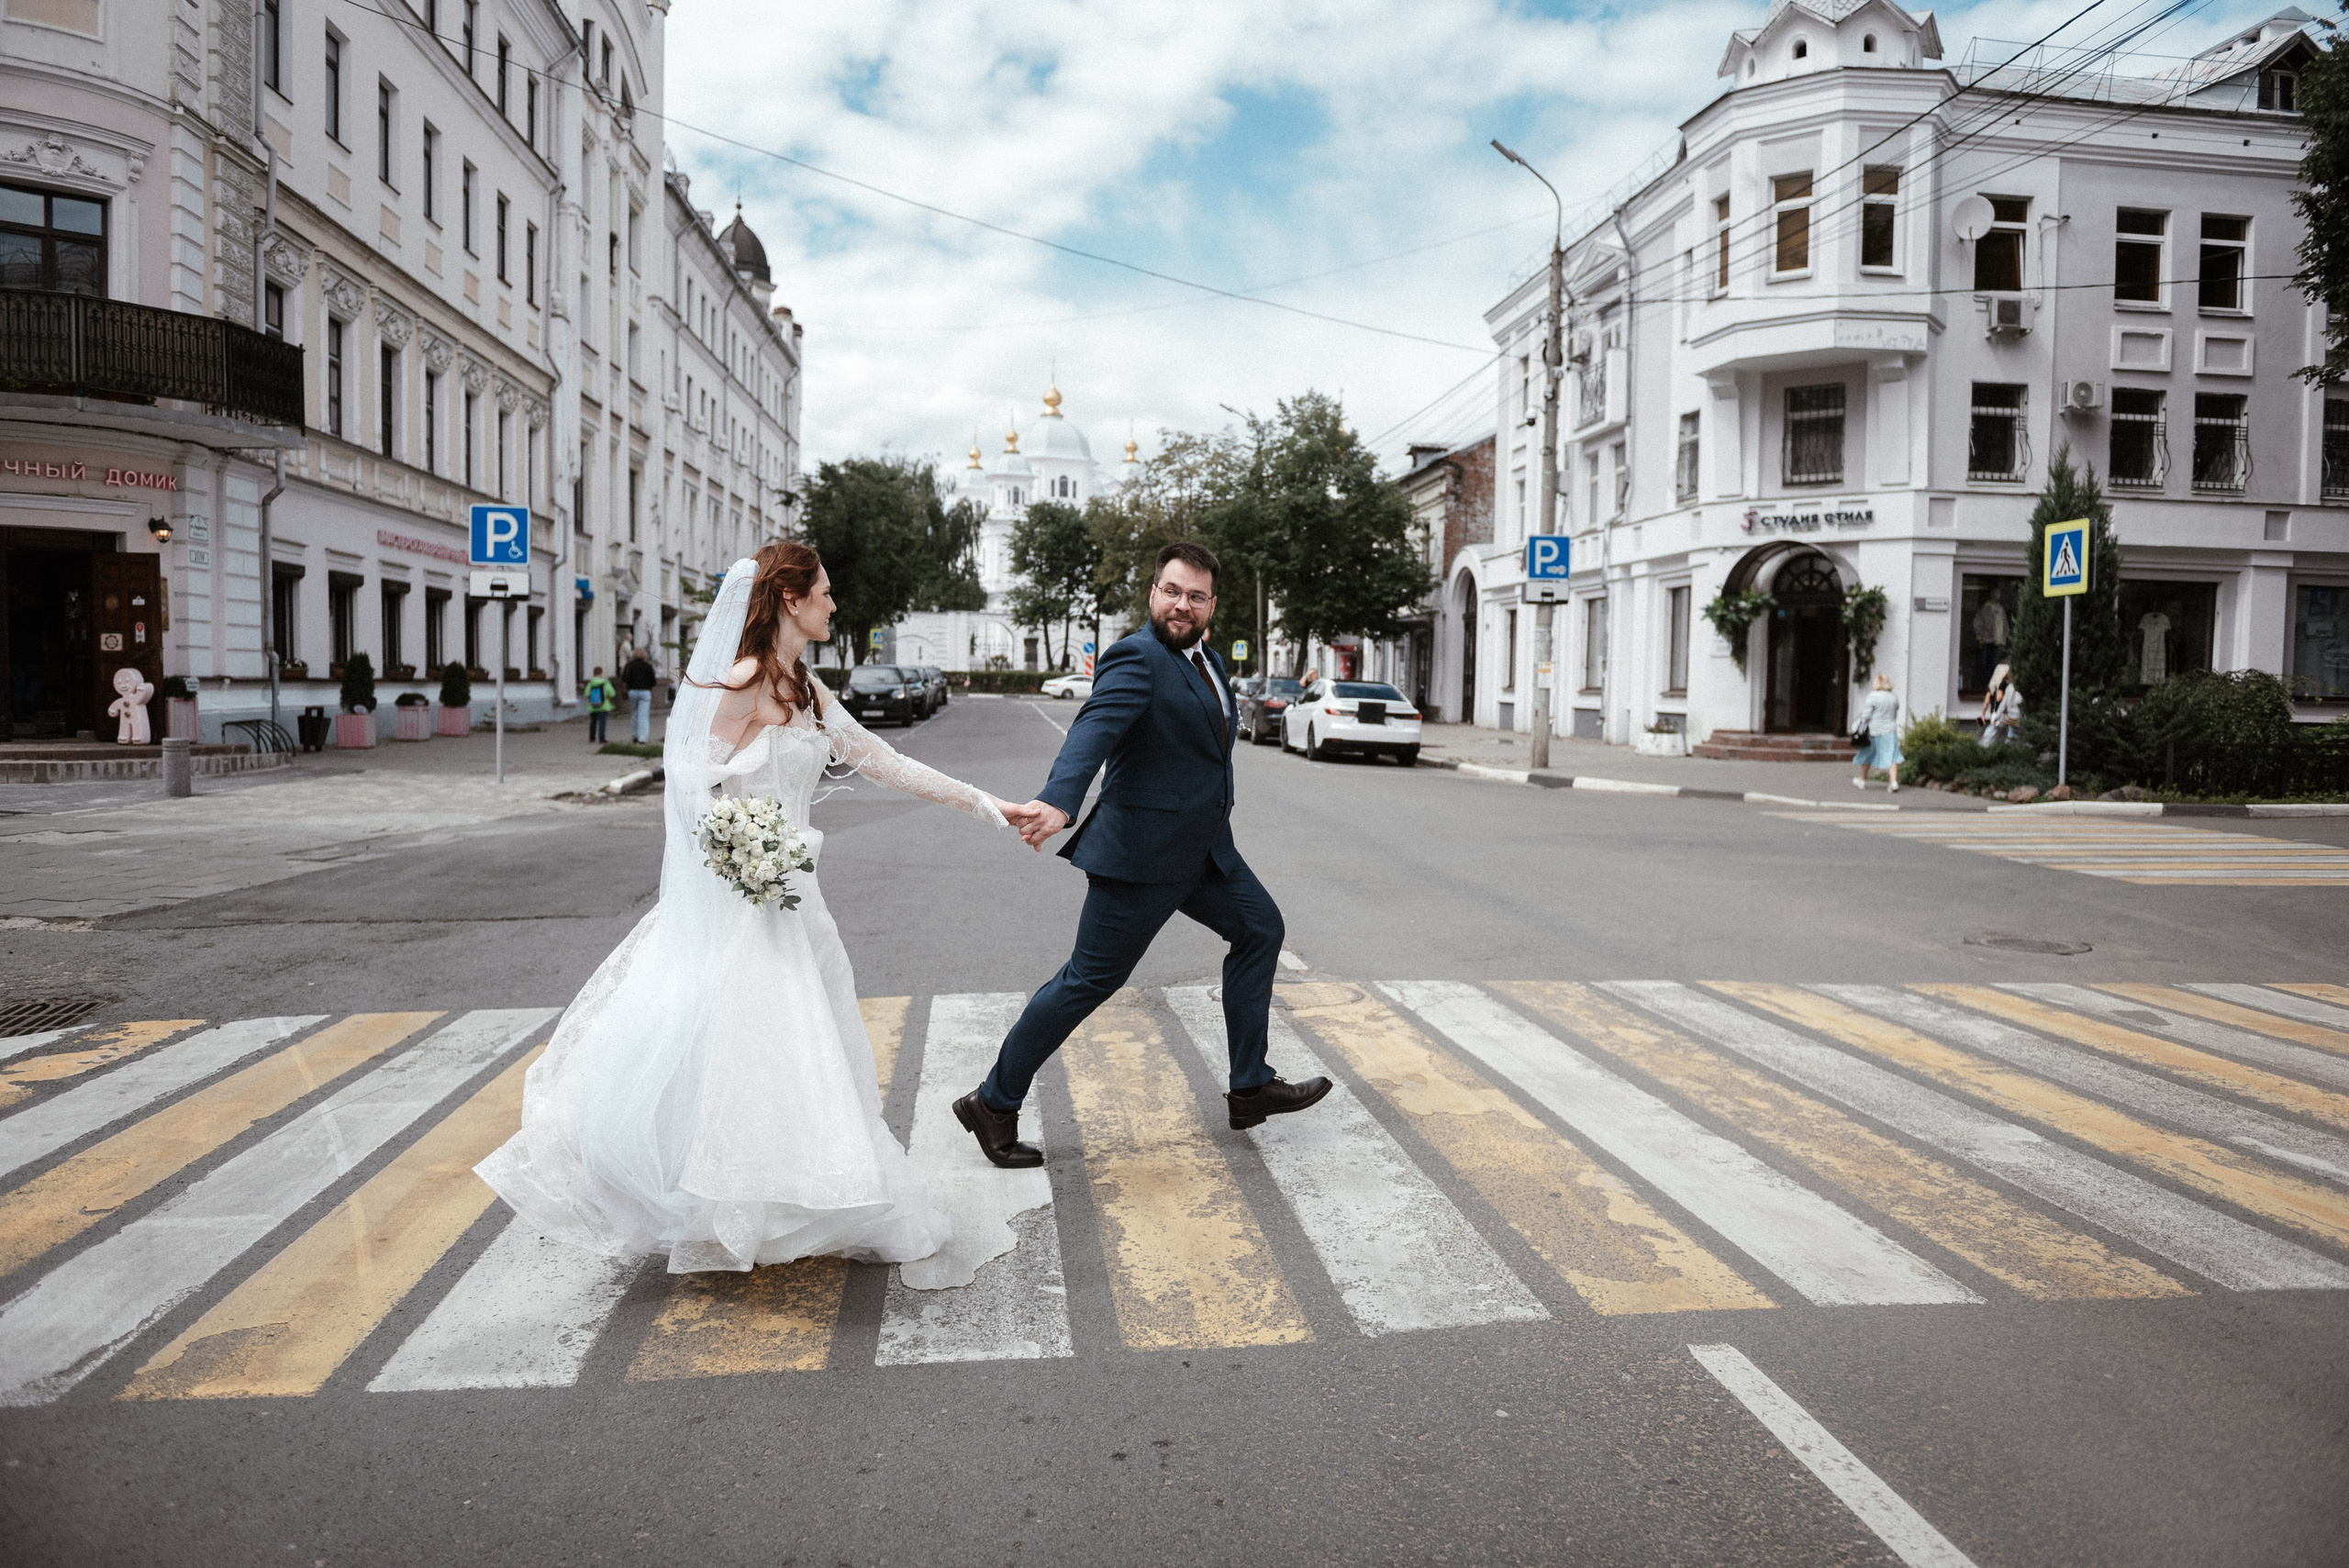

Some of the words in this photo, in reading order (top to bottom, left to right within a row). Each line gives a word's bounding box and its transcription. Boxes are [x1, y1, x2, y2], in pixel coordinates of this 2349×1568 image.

[4, 460, 86, 480] ЧНЫЙ
[106, 469, 177, 491] ДОМИК
[486, 511, 518, 558] P
[1761, 514, 1819, 528] СТУДИЯ
[1824, 510, 1873, 524] СТИЛЯ
[1535, 539, 1559, 576] P
